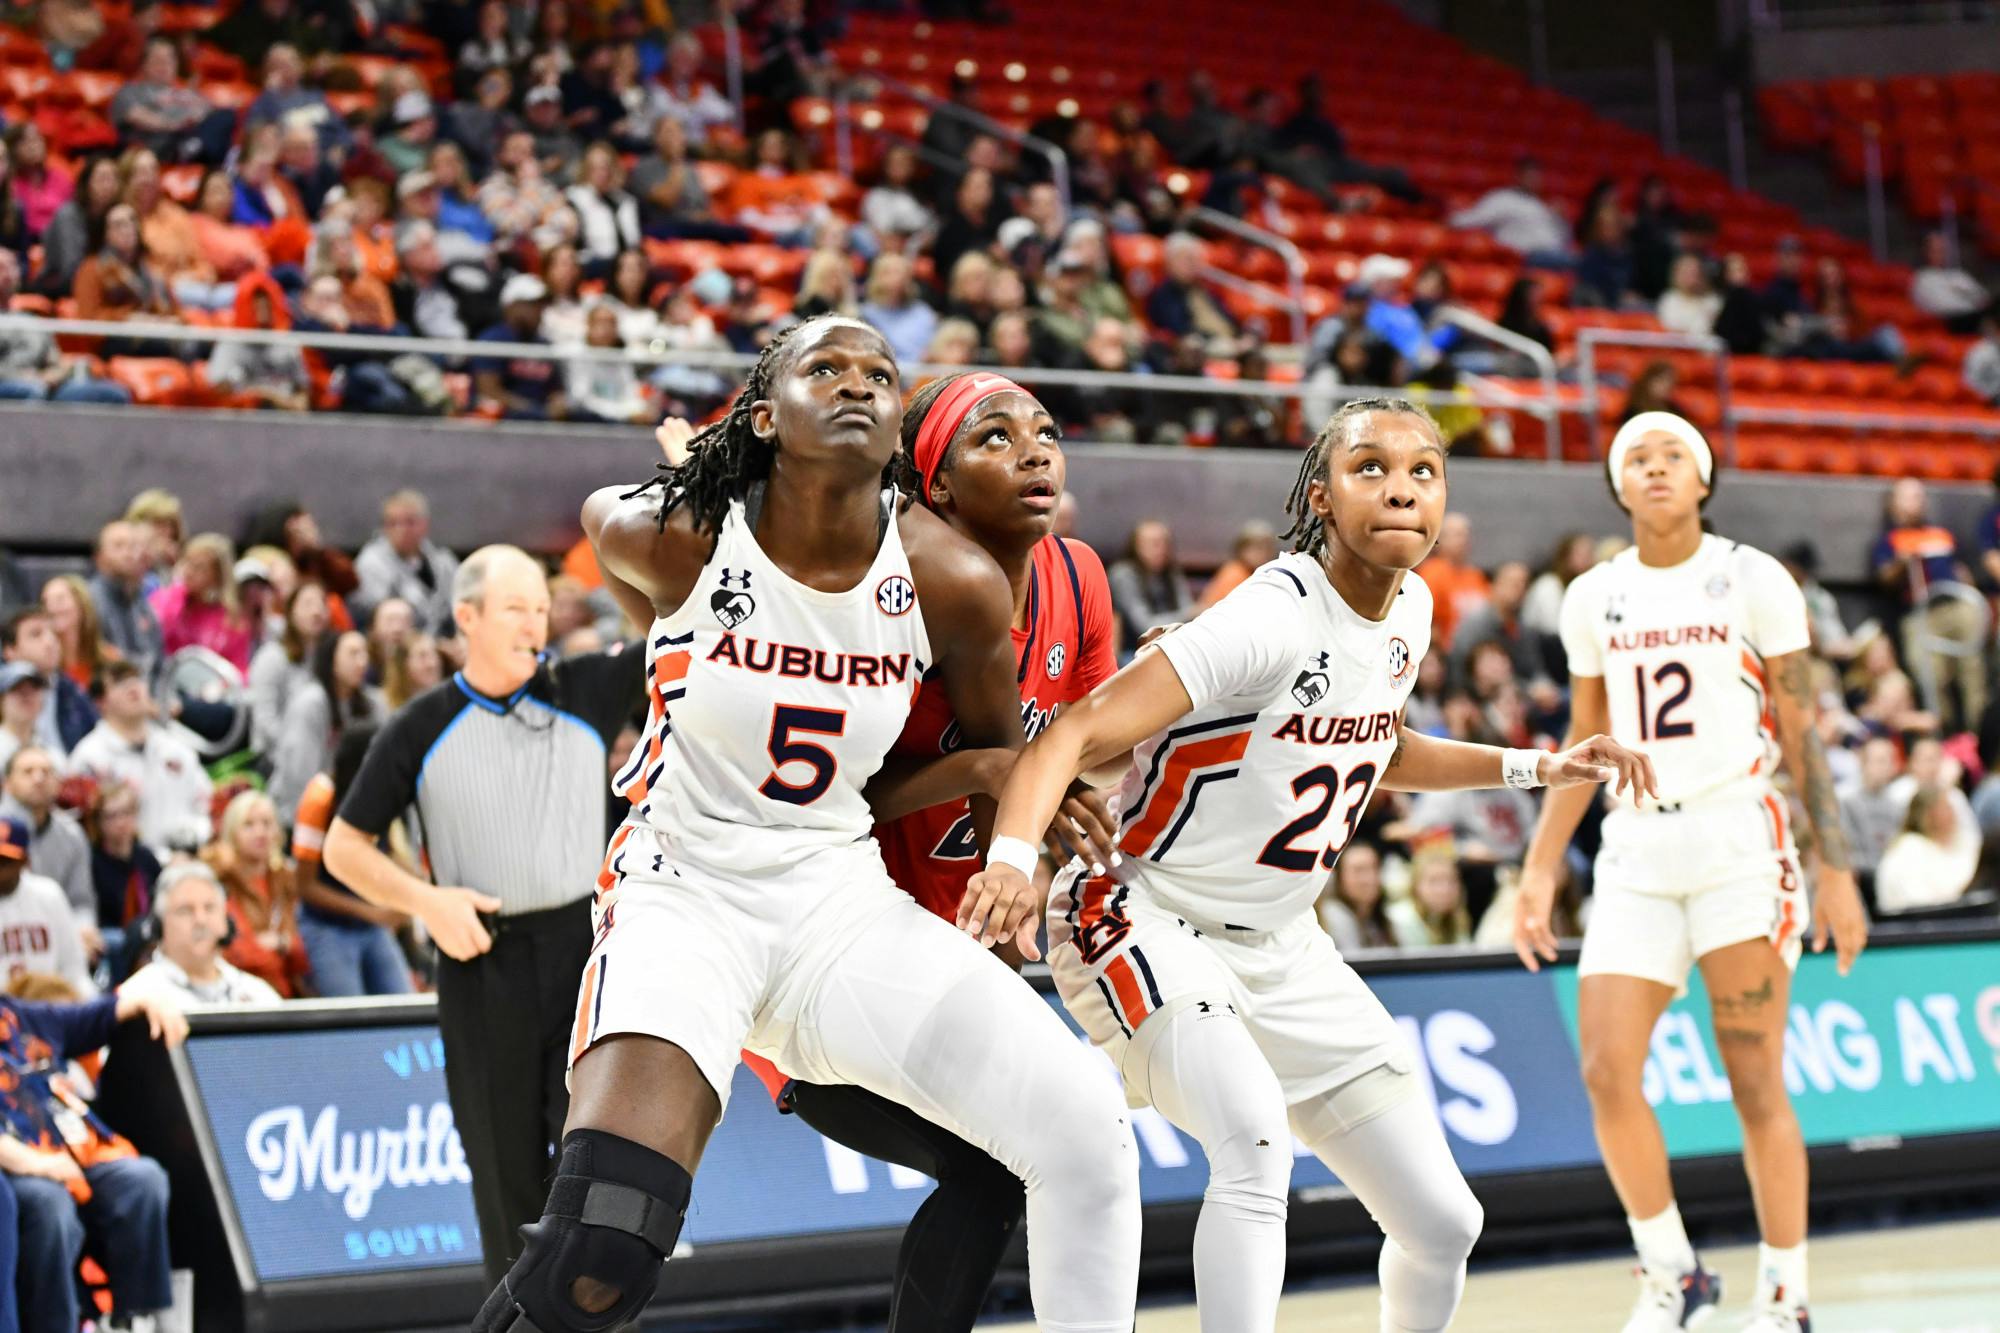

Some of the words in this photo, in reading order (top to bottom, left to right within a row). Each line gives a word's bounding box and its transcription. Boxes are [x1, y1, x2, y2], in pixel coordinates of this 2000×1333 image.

[877, 576, 914, 615] SEC
[706, 630, 911, 687] AUBURN
[1608, 624, 1729, 650] AUBURN
[1635, 661, 1695, 742] 12
[758, 702, 847, 806] 5
[1255, 761, 1376, 872] 23
[1894, 993, 1977, 1086] AT
[344, 1223, 465, 1260] SOUTH
